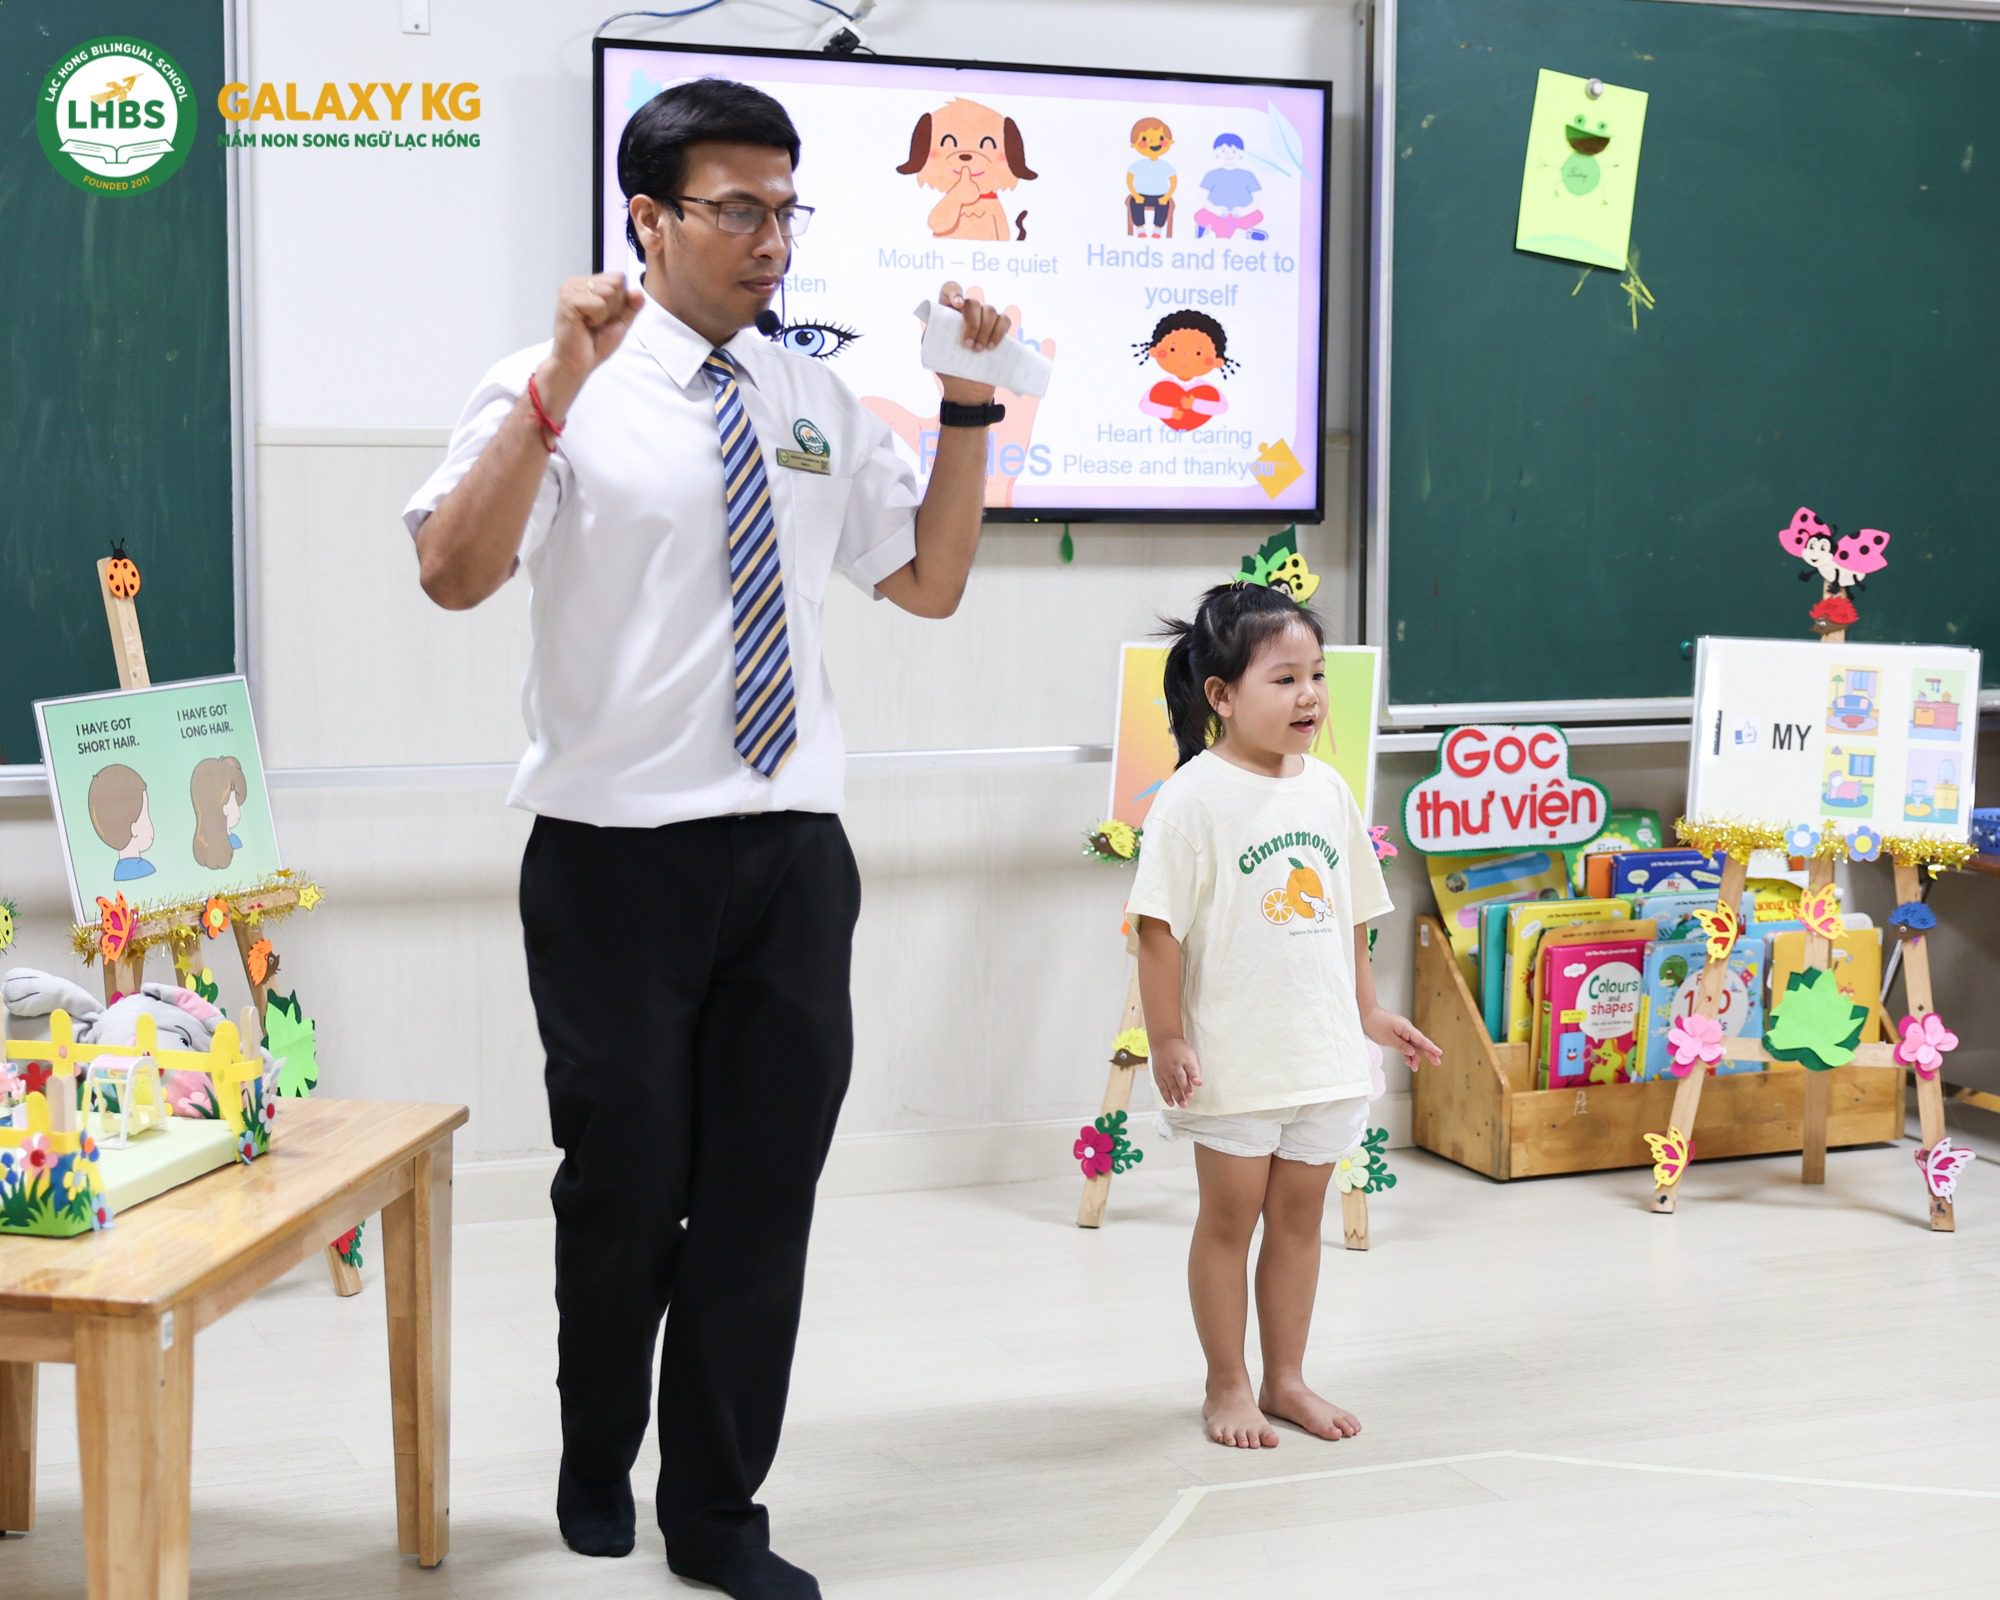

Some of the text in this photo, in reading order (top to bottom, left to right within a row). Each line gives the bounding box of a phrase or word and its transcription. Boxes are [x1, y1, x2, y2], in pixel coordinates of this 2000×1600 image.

[878, 249, 944, 270] Mouth
[972, 251, 1001, 272] Be
[1007, 254, 1059, 278] quiet
[1086, 243, 1295, 273] Hands and feet to
[784, 273, 827, 293] sten
[1144, 284, 1240, 310] yourself
[1097, 424, 1253, 449] Heart for caring
[919, 430, 1053, 477] Rles
[1063, 455, 1276, 481] Please and thankyou
[177, 704, 228, 722] I HAVE GOT
[76, 717, 132, 737] I HAVE GOT
[180, 721, 234, 739] LONG HAIR.
[1772, 723, 1812, 751] MY
[77, 735, 140, 755] SHORT HAIR.
[1416, 778, 1598, 839] thư viện
[1238, 831, 1340, 875] Cinnamoroll
[1588, 975, 1639, 1000] Colours
[1591, 1001, 1634, 1018] shapes
